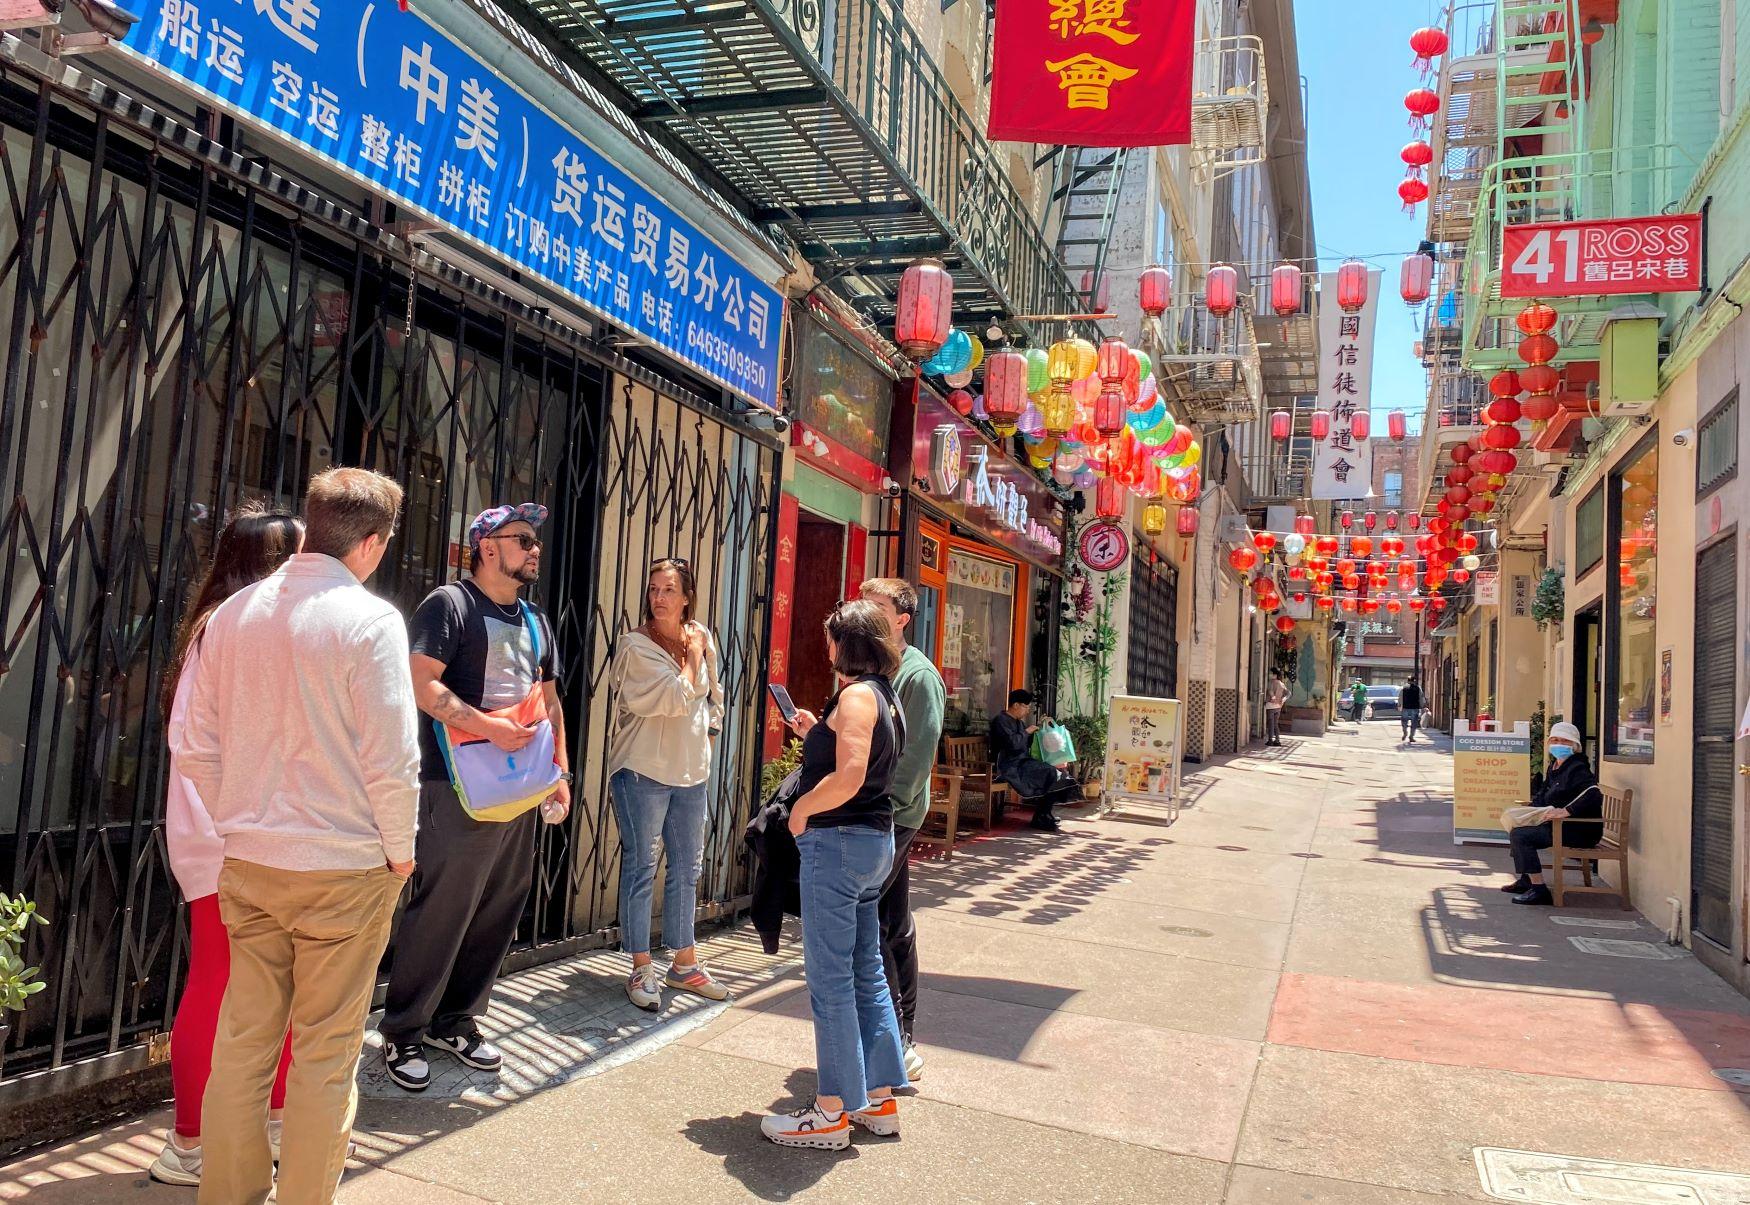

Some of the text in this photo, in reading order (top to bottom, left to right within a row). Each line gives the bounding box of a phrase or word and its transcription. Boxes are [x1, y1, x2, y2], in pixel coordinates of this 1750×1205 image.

[1044, 0, 1142, 111] 總會
[158, 0, 245, 86] 船运
[269, 60, 340, 141] 空运
[359, 113, 423, 189] 整柜
[437, 161, 492, 228] 拼柜
[505, 202, 631, 312] 订购中美产品
[687, 320, 766, 390] 6463509350
[1511, 225, 1690, 284] 41 ROSS
[1583, 258, 1689, 282] 舊呂宋巷
[1476, 758, 1508, 767] SHOP
